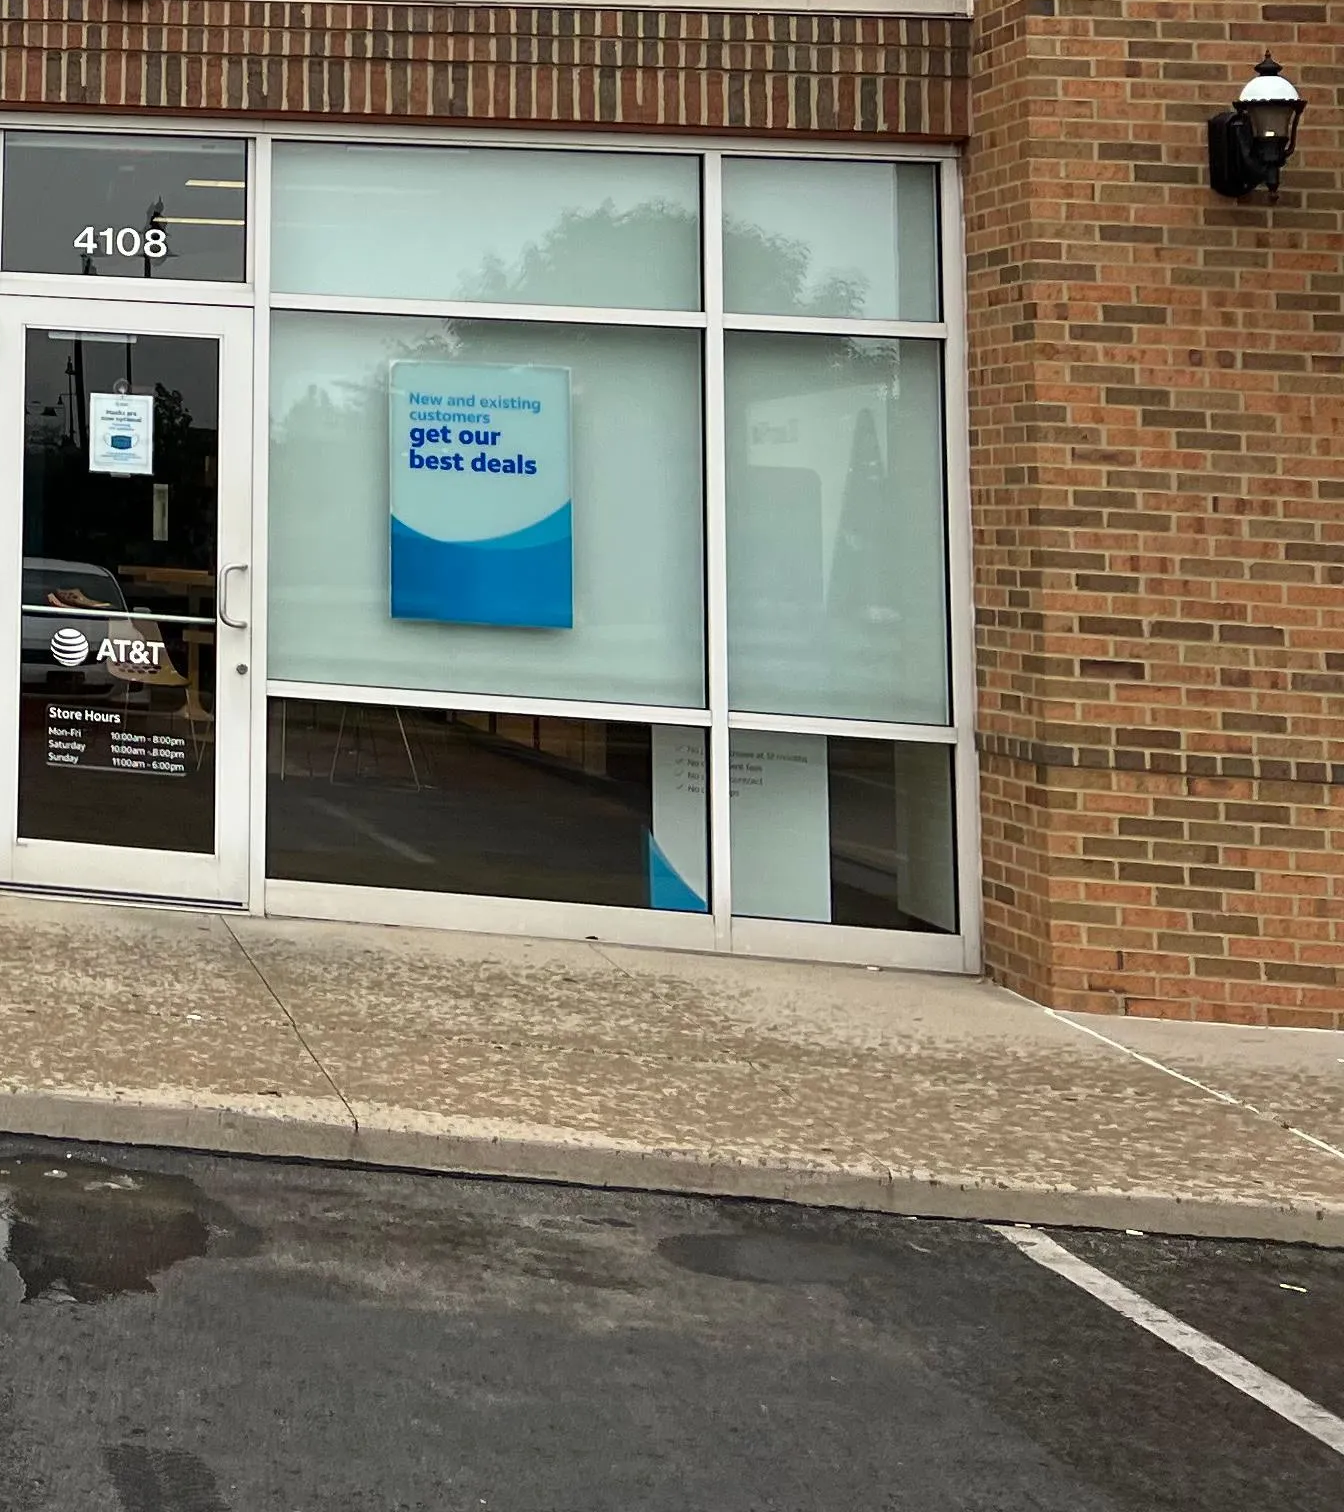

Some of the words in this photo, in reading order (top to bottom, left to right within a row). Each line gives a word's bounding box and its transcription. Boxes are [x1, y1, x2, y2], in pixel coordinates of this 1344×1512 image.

[73, 226, 168, 258] 4108
[409, 392, 442, 406] New
[447, 395, 476, 407] and
[480, 395, 541, 414] existing
[409, 409, 491, 424] customers
[410, 426, 452, 448] get
[459, 429, 501, 445] our
[410, 449, 464, 471] best
[471, 452, 537, 474] deals
[96, 638, 165, 665] AT&T
[49, 706, 82, 720] Store
[85, 709, 121, 723] Hours
[48, 726, 82, 738] Mon-Fri
[152, 735, 185, 746] 8:00pm
[48, 739, 86, 752] Saturday
[110, 744, 145, 756] 10:00am
[48, 751, 79, 765] Sunday
[152, 761, 185, 772] 6:00pm
